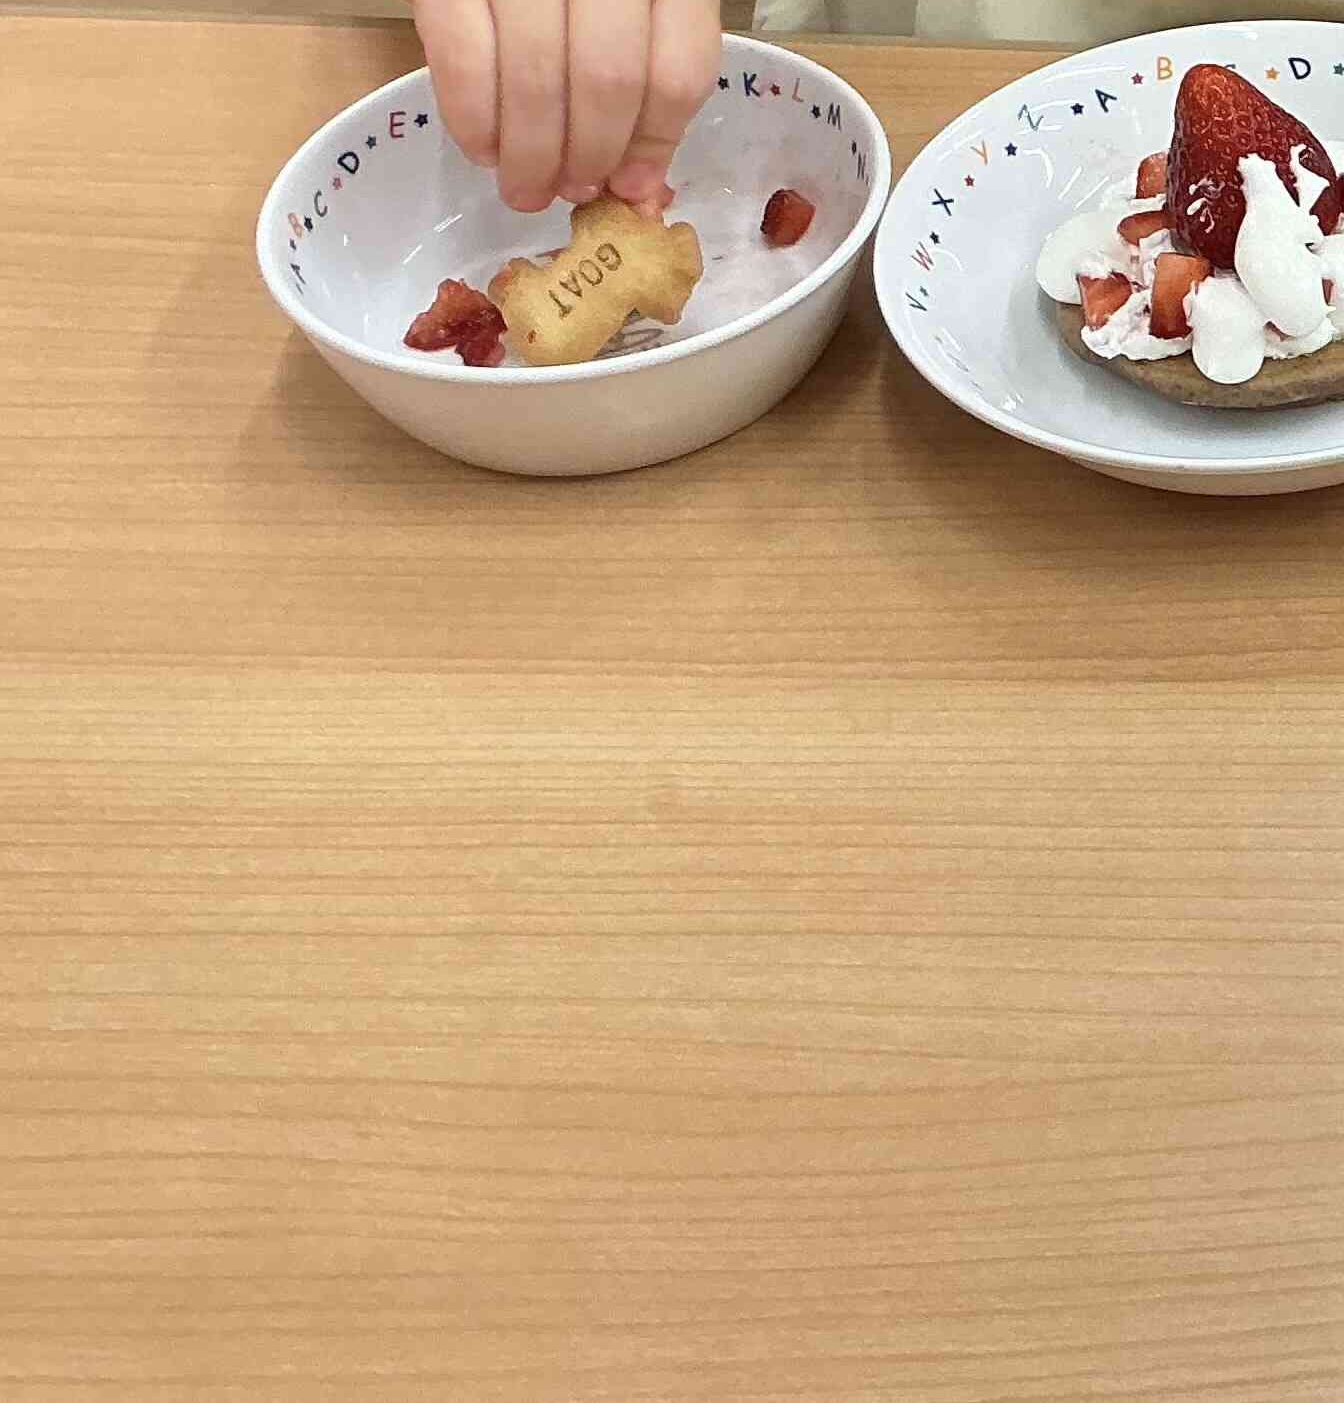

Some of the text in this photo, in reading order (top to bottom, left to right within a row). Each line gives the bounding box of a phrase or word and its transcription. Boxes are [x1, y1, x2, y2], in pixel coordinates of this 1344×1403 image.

[313, 189, 328, 218] C
[337, 151, 360, 175] D
[389, 111, 407, 139] E
[743, 71, 761, 98] K
[791, 77, 804, 103] L
[827, 102, 842, 130] M
[931, 188, 955, 216] X
[970, 140, 989, 166] Y
[1095, 88, 1117, 113] A
[1156, 56, 1173, 80] B
[1288, 57, 1311, 80] D
[548, 242, 623, 320] GOAT
